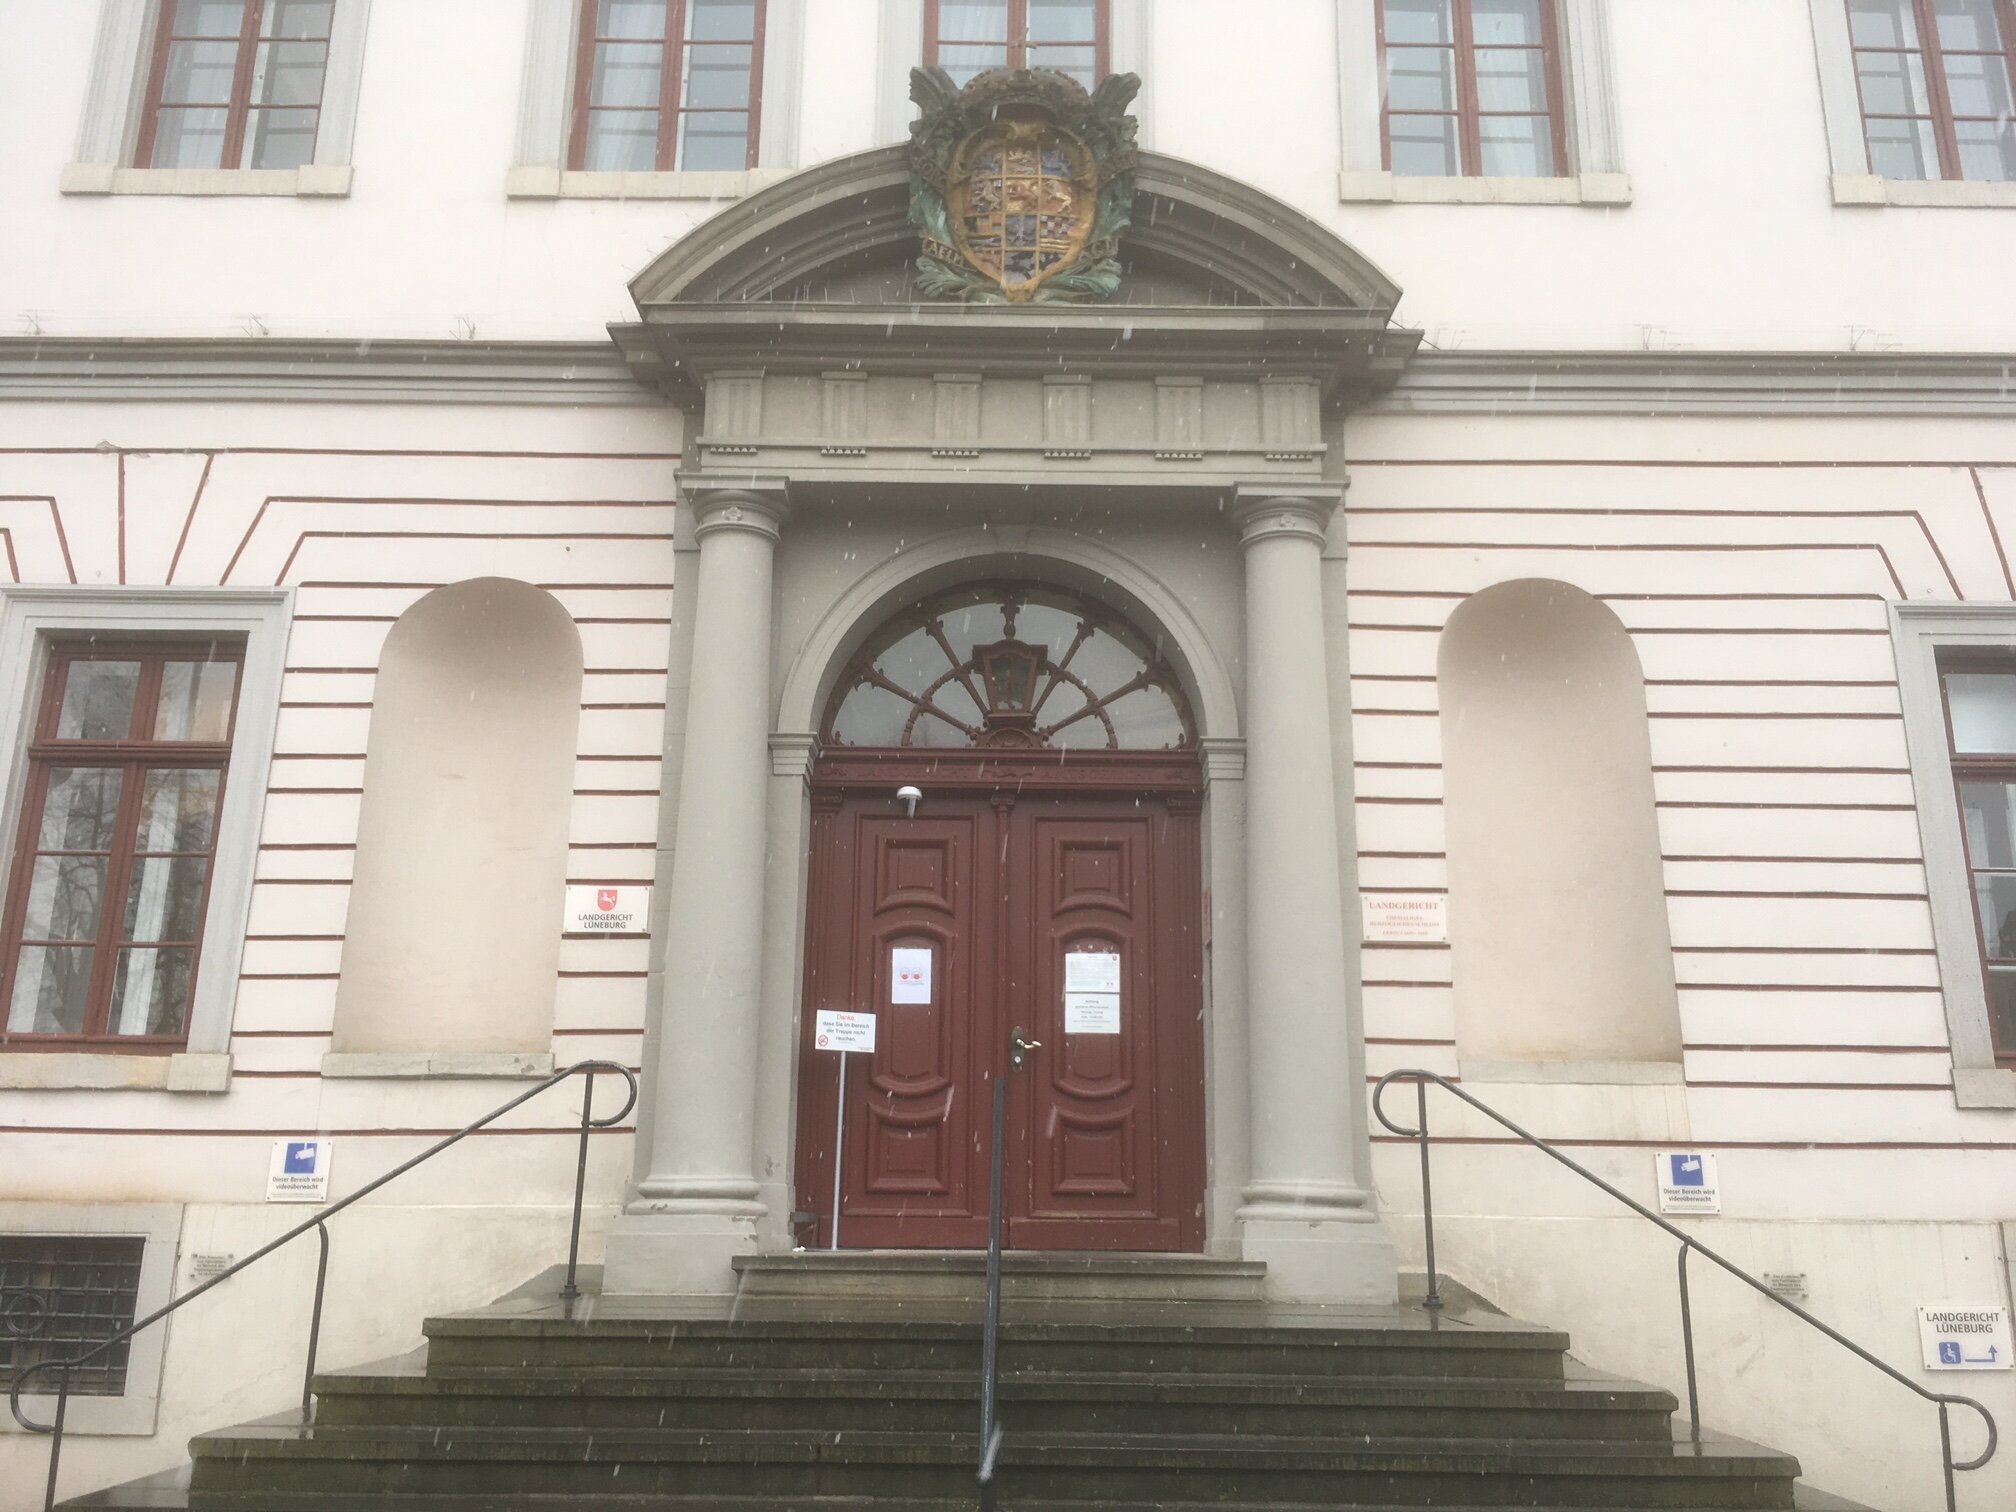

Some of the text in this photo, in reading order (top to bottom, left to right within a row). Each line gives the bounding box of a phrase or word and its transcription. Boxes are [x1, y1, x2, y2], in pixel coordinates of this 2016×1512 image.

[1369, 902, 1438, 910] LANDGERICHT
[584, 921, 626, 929] LÜNEBURG
[1926, 1312, 1999, 1322] LANDGERICHT
[1936, 1322, 1993, 1333] LÜNEBURG
